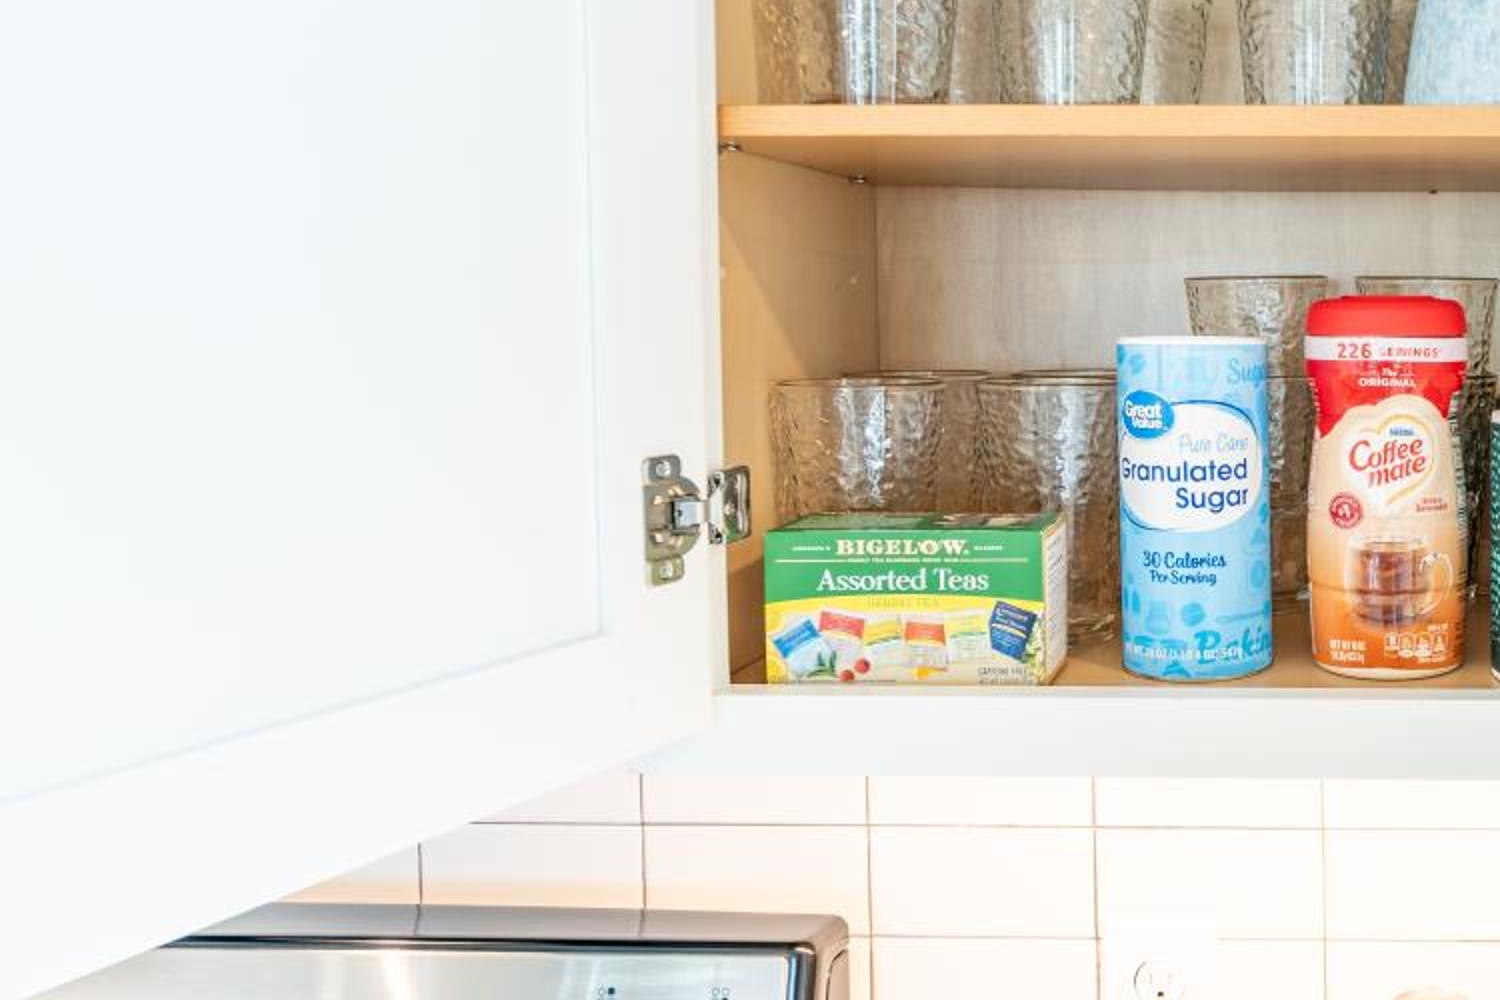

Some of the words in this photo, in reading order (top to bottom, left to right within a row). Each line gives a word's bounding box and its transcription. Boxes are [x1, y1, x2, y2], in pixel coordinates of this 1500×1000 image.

[1337, 343, 1372, 358] 226
[1125, 400, 1163, 420] Great
[1348, 438, 1423, 473] Coffee
[1122, 457, 1248, 483] Granulated
[1367, 455, 1427, 488] mate
[1175, 487, 1249, 513] Sugar
[1143, 551, 1161, 568] 30
[1164, 551, 1227, 569] Calories
[816, 567, 927, 592] Assorted
[933, 567, 990, 592] Teas
[1151, 569, 1169, 583] Per
[1170, 569, 1217, 586] Serving
